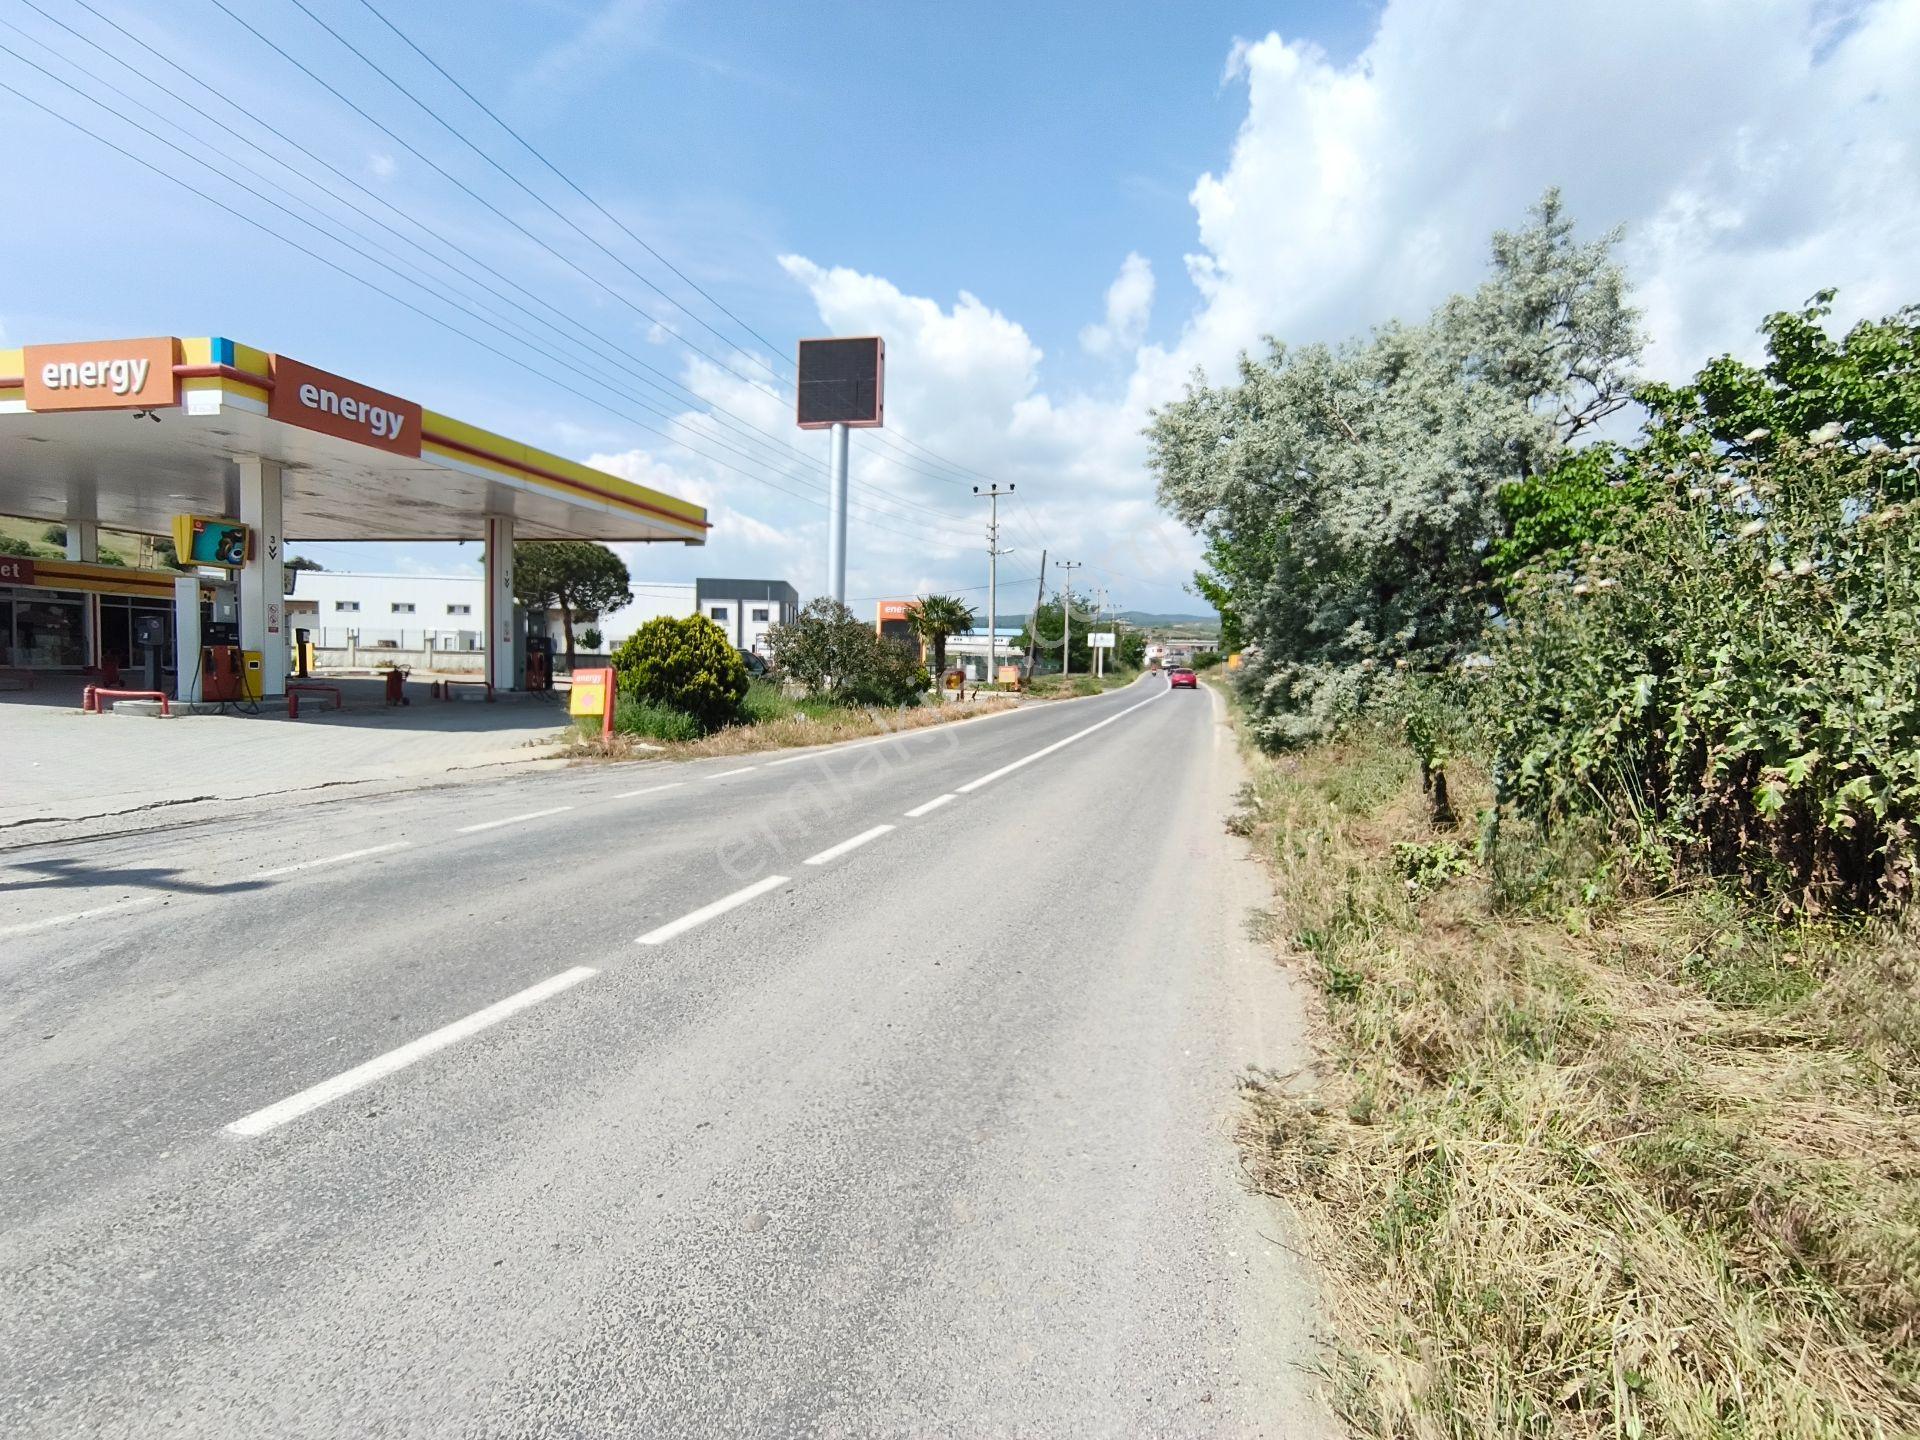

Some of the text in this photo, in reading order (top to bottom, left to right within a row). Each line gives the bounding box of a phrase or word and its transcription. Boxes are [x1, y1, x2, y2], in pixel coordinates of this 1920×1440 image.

[42, 358, 149, 394] energy
[300, 383, 404, 440] energy
[269, 535, 276, 544] 3
[576, 674, 602, 684] energy
